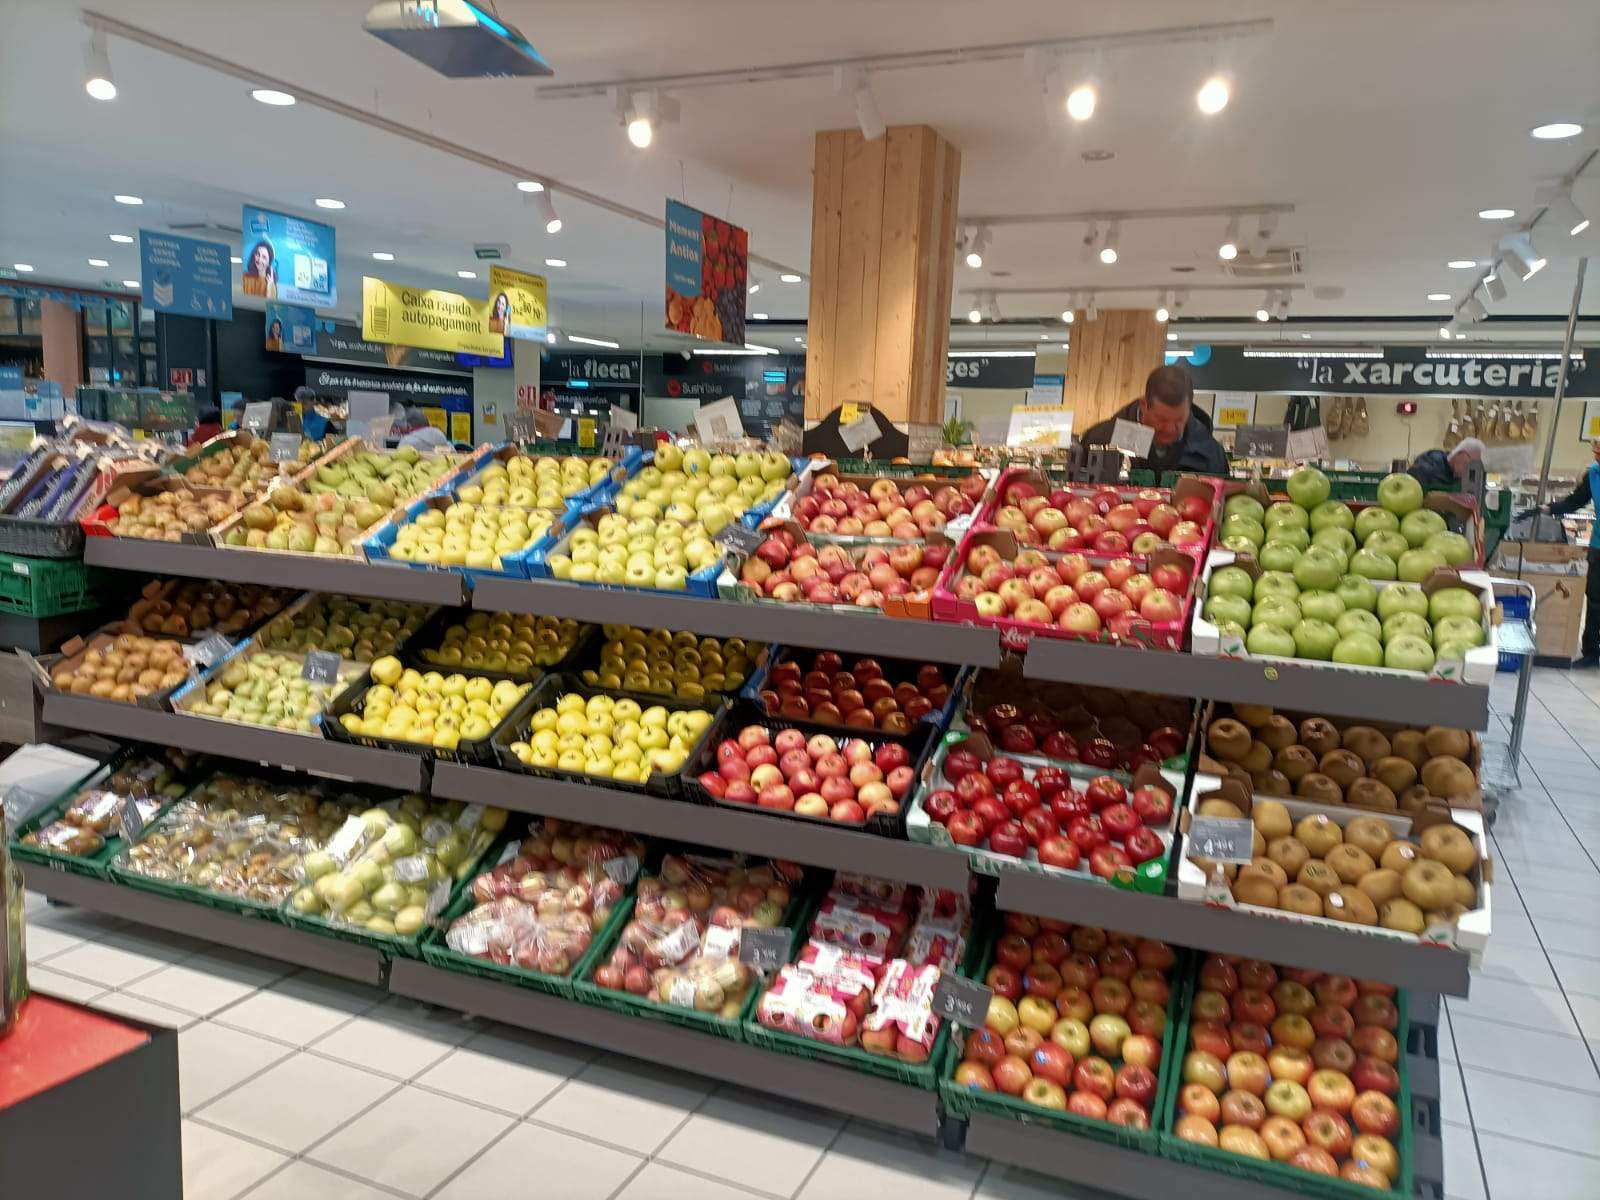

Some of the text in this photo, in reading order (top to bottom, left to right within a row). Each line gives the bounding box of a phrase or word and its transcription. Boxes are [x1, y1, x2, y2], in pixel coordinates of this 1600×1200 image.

[670, 241, 699, 263] Antiox
[401, 290, 433, 310] Caixa
[402, 310, 482, 335] autopagament
